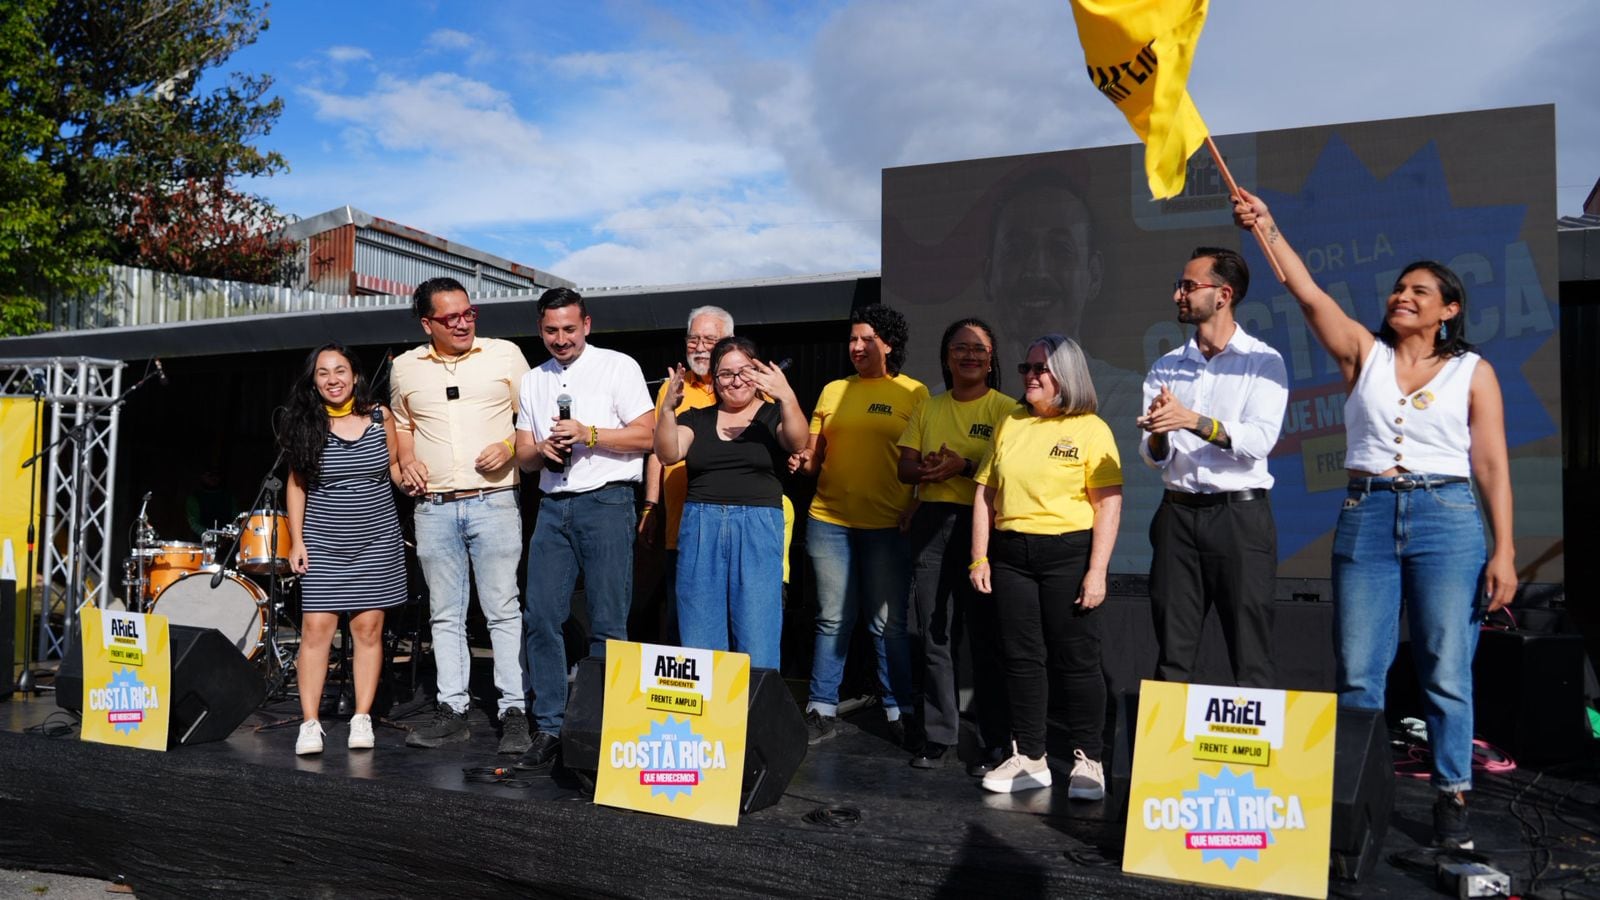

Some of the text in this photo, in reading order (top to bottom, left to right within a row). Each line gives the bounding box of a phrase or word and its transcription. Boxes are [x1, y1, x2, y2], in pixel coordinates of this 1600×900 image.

[1305, 233, 1395, 275] OR LA
[659, 679, 694, 688] PRESIDENTE
[89, 686, 158, 710] COSTA RICA
[651, 694, 697, 707] FRENTE AMPLIO
[1210, 725, 1259, 735] PRESIDENTE
[611, 740, 726, 769] COSTA RICA
[1199, 743, 1262, 757] FRENTE AMPLIO
[643, 773, 696, 783] QUE MERECEMOS
[1143, 796, 1305, 830] COSTA RICA
[1190, 834, 1263, 848] QUE MERECEMOS
